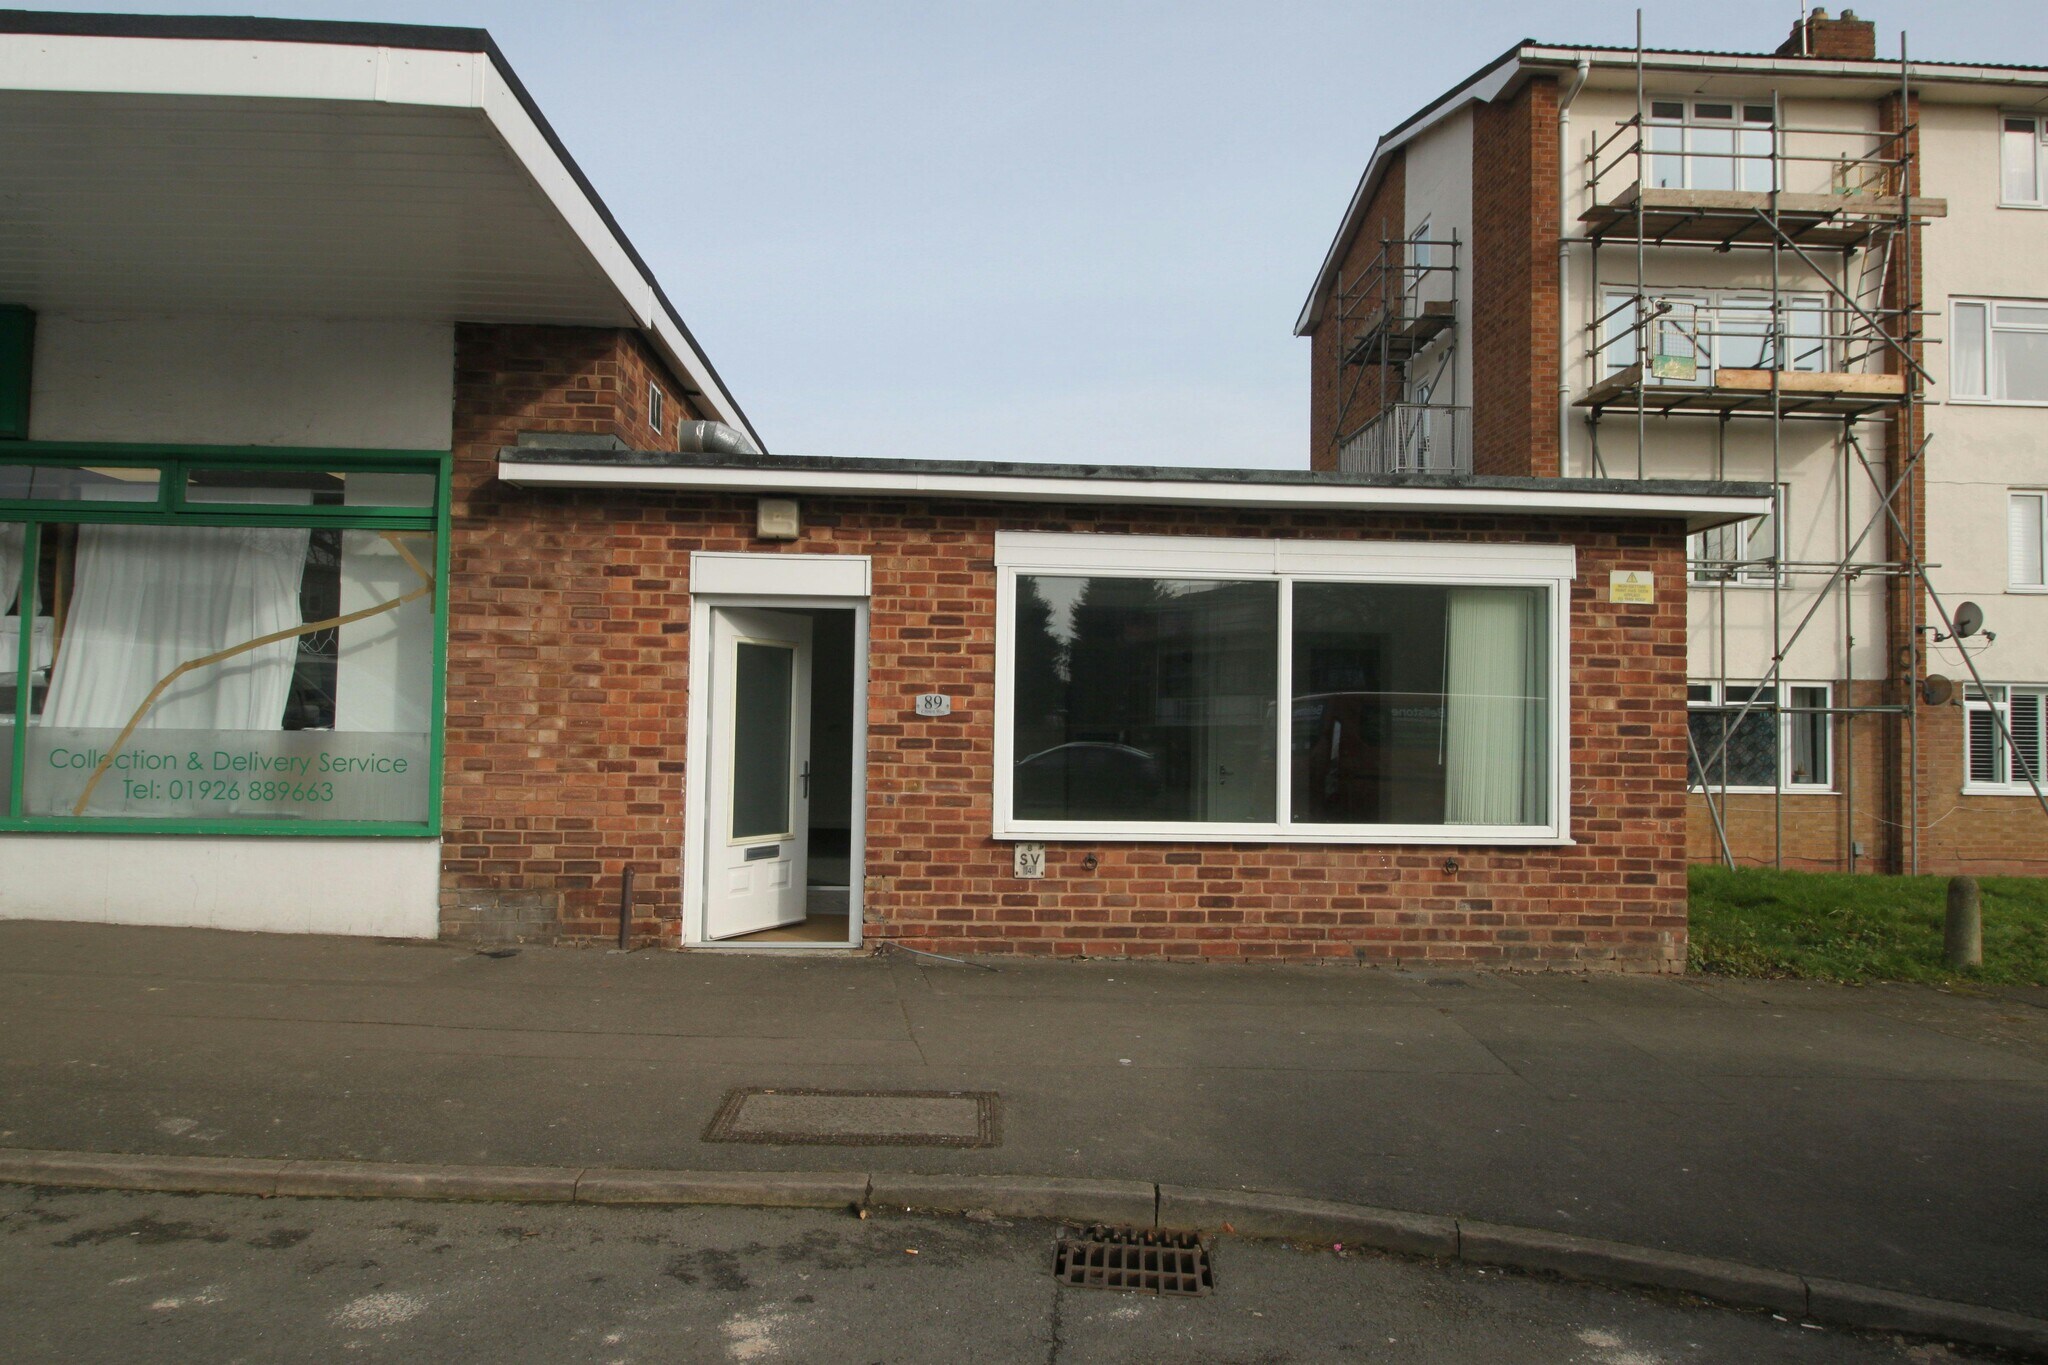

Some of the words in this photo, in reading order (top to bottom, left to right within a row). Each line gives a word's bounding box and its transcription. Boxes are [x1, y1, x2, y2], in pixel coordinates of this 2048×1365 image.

[924, 695, 942, 709] 89
[49, 748, 177, 771] Collection
[187, 752, 204, 771] &
[213, 751, 309, 775] Delivery
[319, 752, 409, 774] Service
[123, 779, 161, 800] Tel:
[169, 780, 241, 801] 01926
[249, 781, 334, 803] 889663
